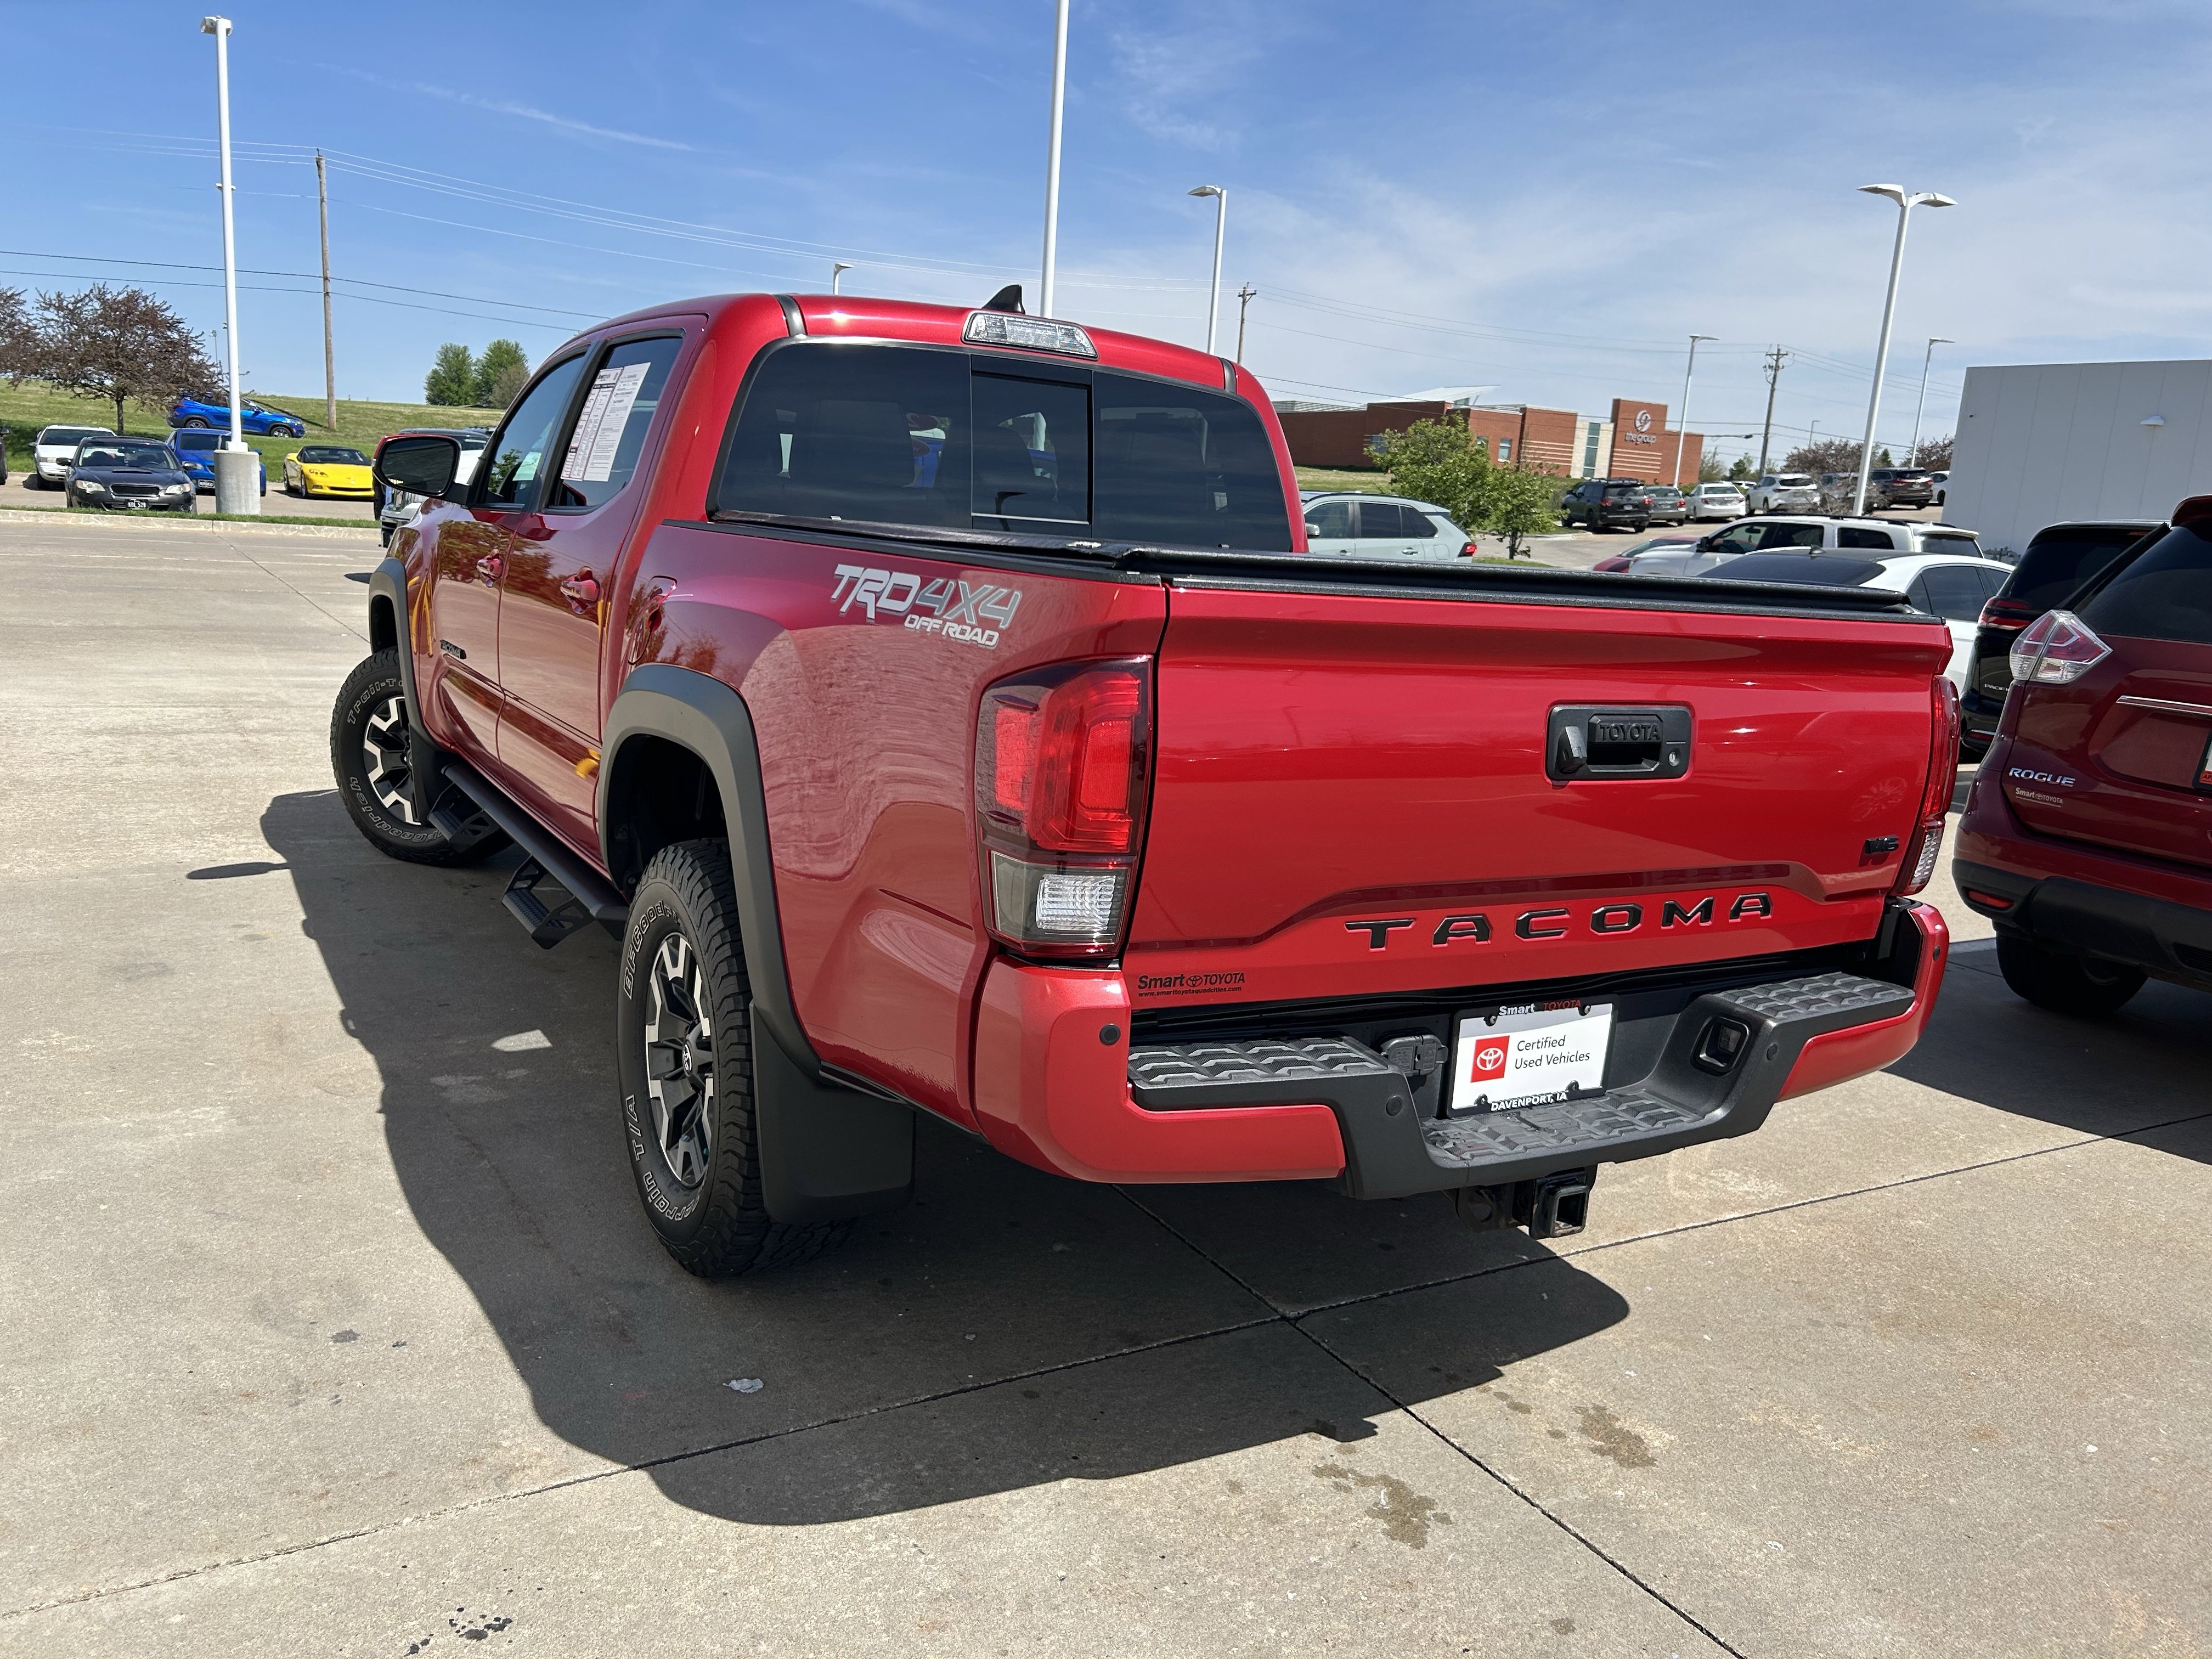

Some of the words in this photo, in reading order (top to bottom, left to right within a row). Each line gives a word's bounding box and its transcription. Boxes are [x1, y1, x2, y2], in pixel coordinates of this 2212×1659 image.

[831, 564, 921, 619] TRD
[904, 614, 943, 632] OFF
[942, 622, 1000, 646] ROAD
[439, 641, 460, 658] TACOMA
[1599, 723, 1661, 741] TOYOTA
[2009, 768, 2076, 786] ROGUE
[2016, 787, 2035, 798] Smart
[2042, 794, 2063, 804] TOYOTA
[349, 776, 443, 842] FGoodrich
[1345, 893, 1773, 951] TACOMA
[1137, 974, 1185, 989] Smart
[1203, 972, 1245, 986] TOYOTA
[1499, 1003, 1535, 1015] Smart
[1543, 999, 1582, 1011] TOYOTA
[1517, 1035, 1566, 1052] Certified
[1515, 1054, 1543, 1069] Used
[1546, 1050, 1590, 1065] Vehicles
[1491, 1093, 1554, 1111] DAVENPORT,
[1556, 1092, 1568, 1101] IA
[625, 1094, 645, 1162] T/A
